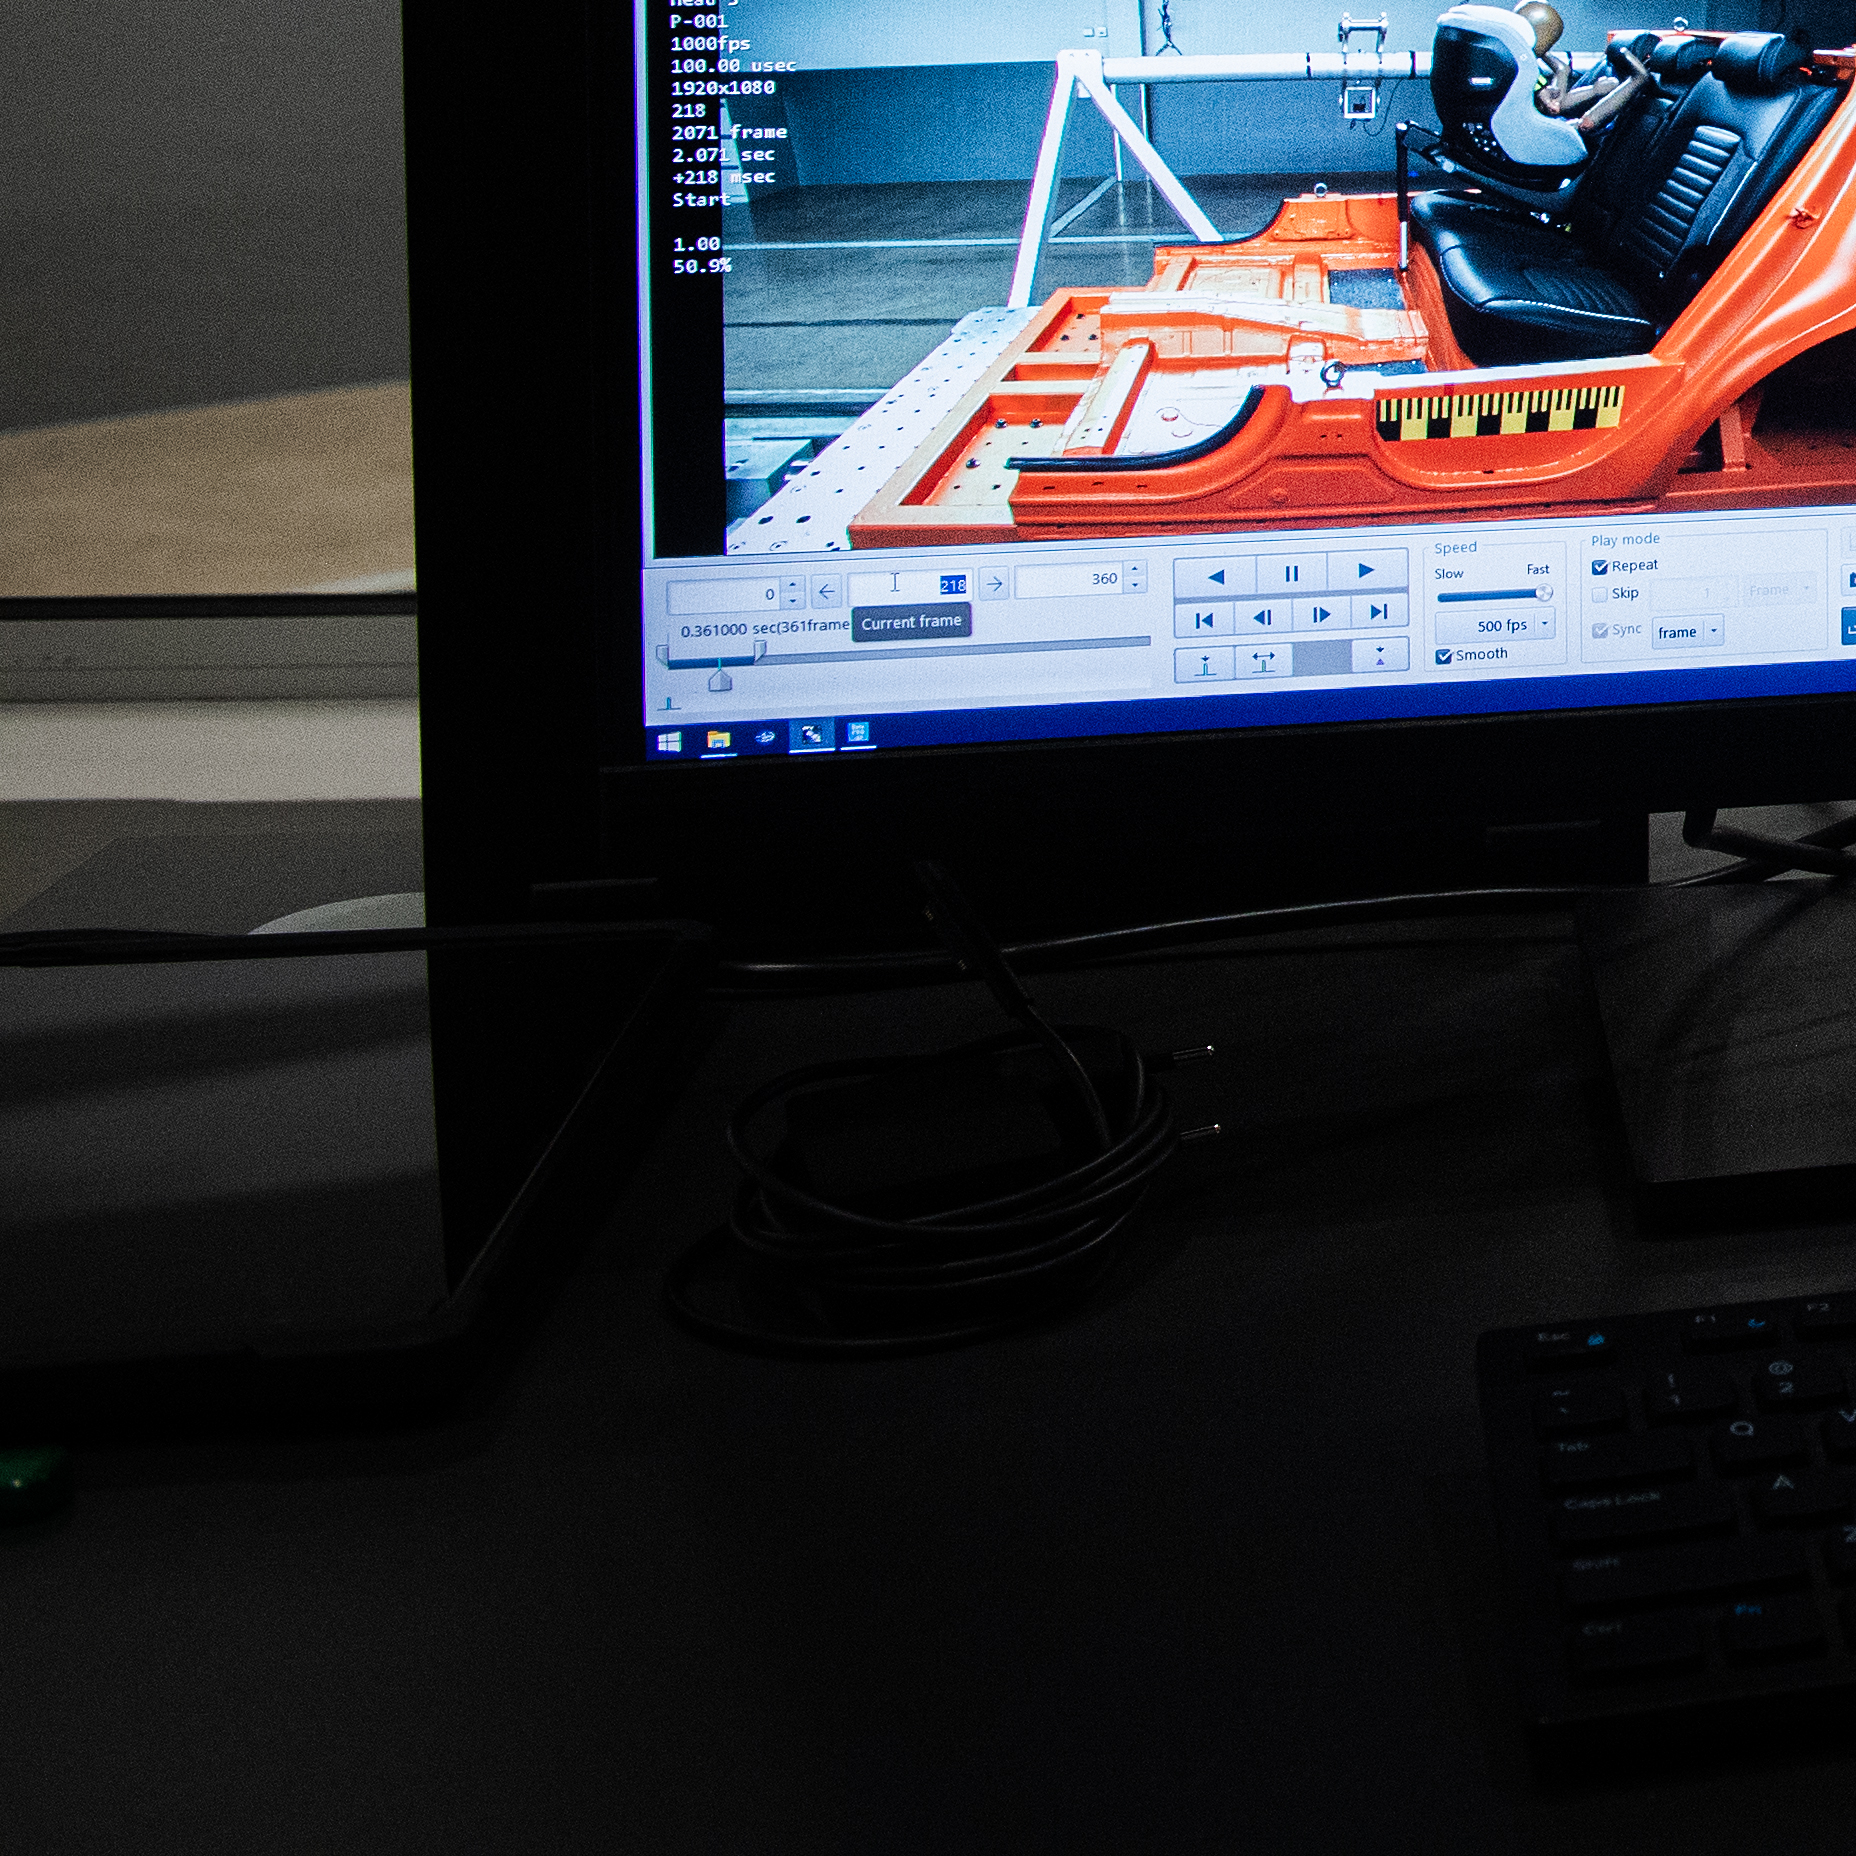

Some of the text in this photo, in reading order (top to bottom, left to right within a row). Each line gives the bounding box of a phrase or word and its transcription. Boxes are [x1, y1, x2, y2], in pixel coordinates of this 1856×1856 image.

[671, 14, 729, 28] P-001
[671, 35, 750, 53] 1000fps
[671, 59, 796, 73] 100.00 usec
[672, 81, 776, 95] 1920x1080
[672, 104, 706, 118] 218
[672, 124, 787, 140] 2071 frame
[673, 148, 775, 163] 2.071 sec
[673, 170, 775, 184] +218 msec
[673, 193, 731, 207] Start
[674, 238, 720, 251] 1.00
[674, 258, 732, 273] 50.9%
[1435, 541, 1477, 556] Speed
[1591, 533, 1660, 549] Play mode
[1435, 567, 1464, 580] Slow
[1527, 563, 1549, 575] Fast
[1613, 559, 1658, 574] Repeat
[941, 578, 966, 594] 218
[1092, 572, 1118, 586] 360
[765, 589, 774, 600] 0
[1613, 586, 1639, 602] Skip
[682, 622, 747, 637] 0.361000
[862, 613, 962, 631] Current frame
[1478, 618, 1527, 633] 500 fps
[1613, 623, 1642, 639] Sync
[1658, 625, 1697, 640] frame
[1457, 648, 1508, 661] Smooth
